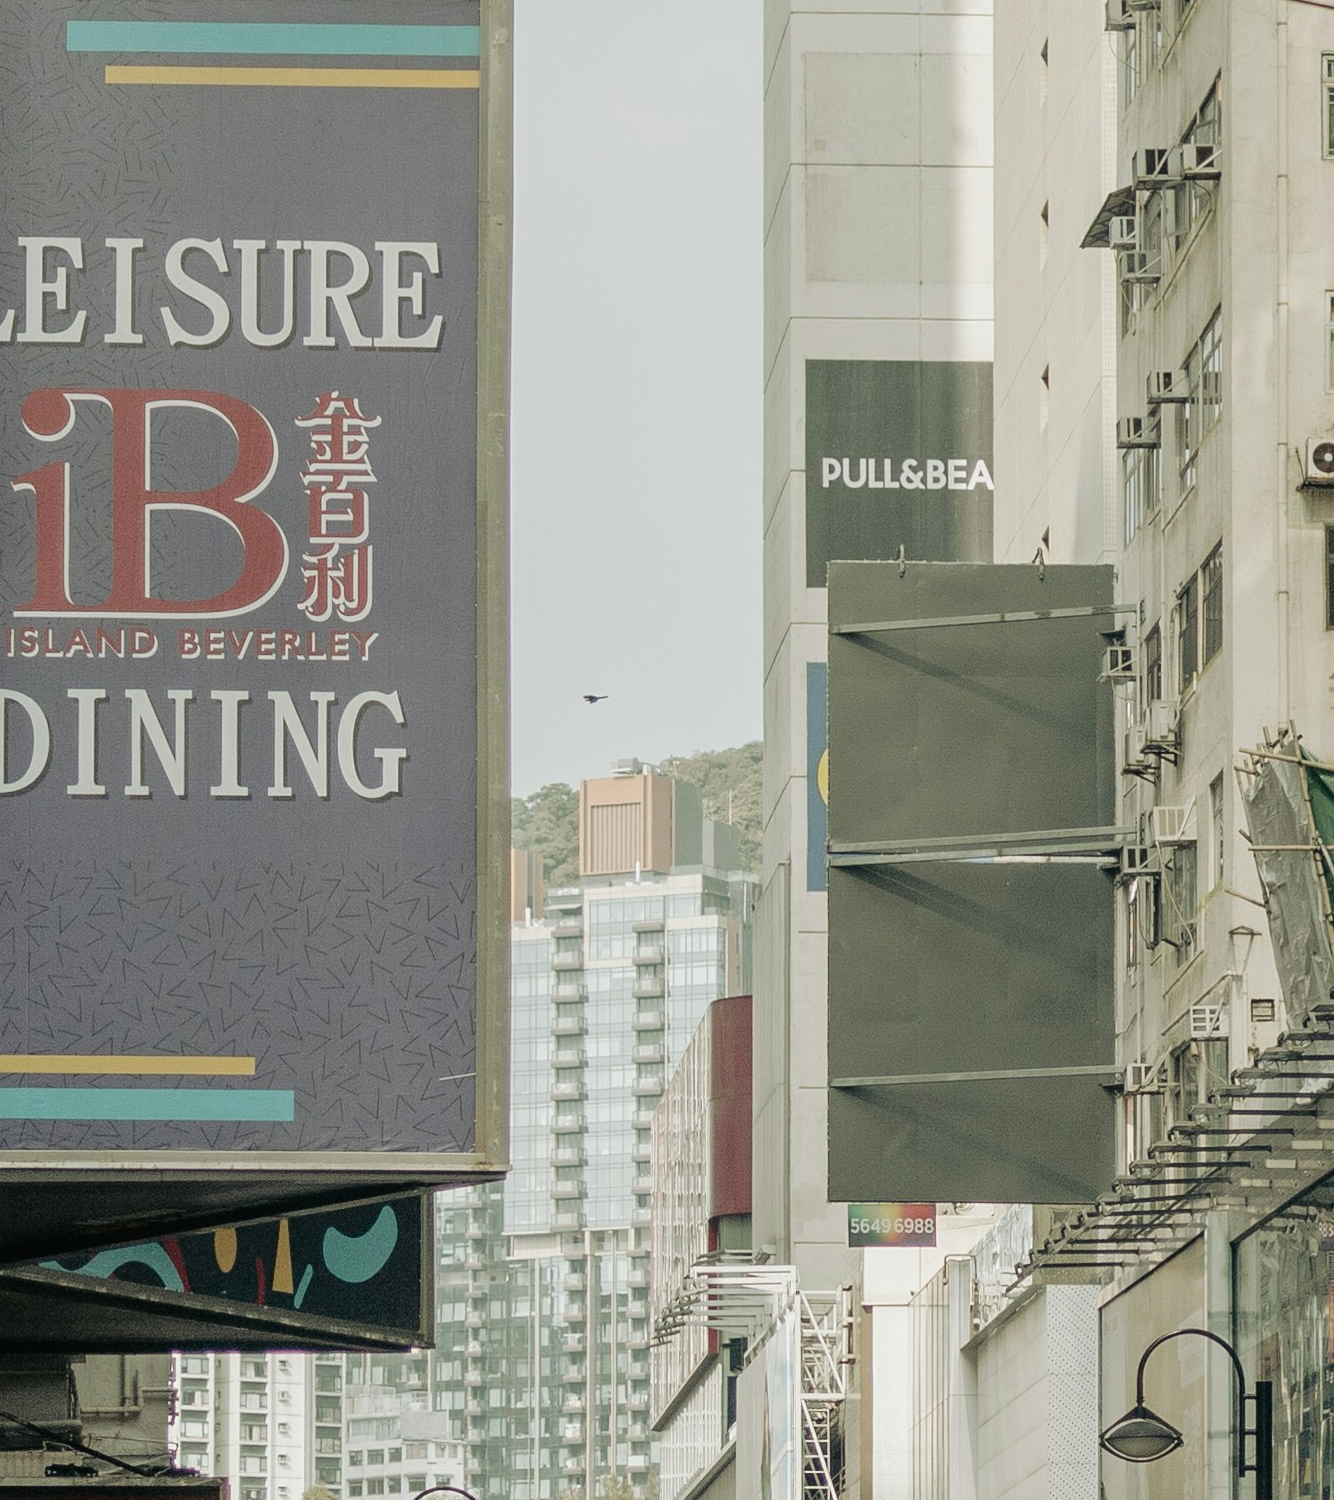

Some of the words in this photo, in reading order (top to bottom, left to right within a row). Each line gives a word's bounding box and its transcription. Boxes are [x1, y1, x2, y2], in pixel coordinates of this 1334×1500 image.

[10, 386, 291, 620] iB
[294, 390, 383, 625] 金百利
[4, 626, 158, 661] ISLAND
[178, 629, 379, 663] BEVERLEY
[850, 1217, 892, 1233] 5649
[894, 1217, 934, 1233] 6988
